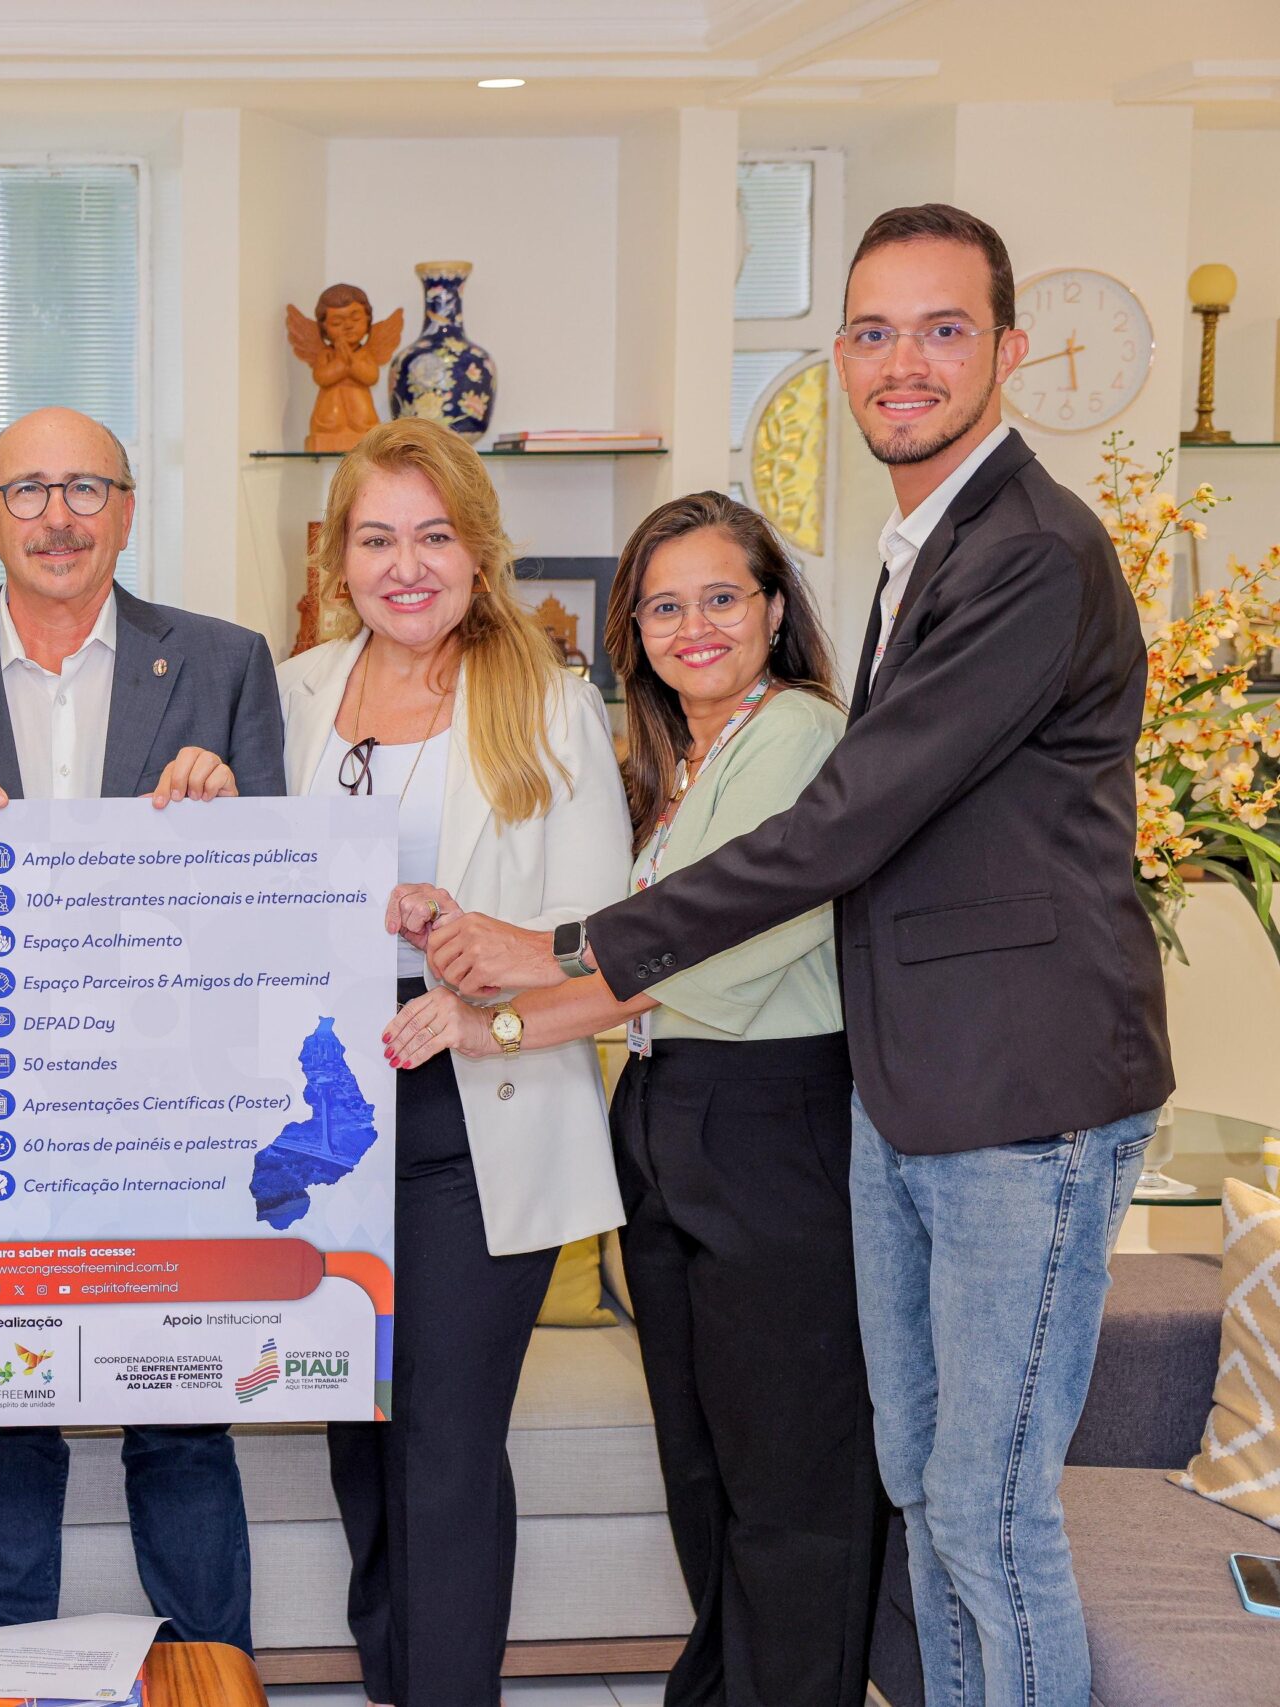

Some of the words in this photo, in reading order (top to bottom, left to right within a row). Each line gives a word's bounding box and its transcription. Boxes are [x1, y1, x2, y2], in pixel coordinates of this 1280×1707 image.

[1036, 290, 1051, 311] 11
[1064, 281, 1082, 304] 12
[1099, 290, 1104, 311] 1
[1015, 311, 1034, 332] 0
[1113, 311, 1128, 333] 2
[1121, 340, 1136, 362] 3
[1010, 372, 1024, 392] 8
[1111, 370, 1125, 389] 4
[1032, 392, 1046, 412] 7
[1059, 397, 1073, 420] 6
[1088, 392, 1103, 413] 5
[23, 852, 77, 867] Amplo
[77, 851, 136, 866] debate
[137, 850, 182, 865] sobre
[183, 849, 251, 868] políticas
[252, 848, 318, 867] públicas
[26, 893, 63, 908] 100+
[64, 892, 165, 910] palestrantes
[167, 891, 243, 906] nacionais
[244, 894, 255, 905] e
[257, 889, 367, 905] internacionais
[23, 934, 80, 952] Espaço
[81, 933, 183, 948] Acolhimento
[23, 976, 80, 993] Espaço
[82, 975, 155, 989] Parceiros
[157, 974, 170, 988] &
[170, 973, 231, 991] Amigos
[233, 972, 254, 987] do
[256, 971, 331, 987] Freemind
[23, 1016, 80, 1031] DEPAD
[82, 1016, 115, 1033] Day
[23, 1057, 44, 1072] 50
[46, 1056, 118, 1071] estandes
[22, 1097, 140, 1115] Apresentações
[142, 1095, 225, 1110] Científicas
[227, 1094, 291, 1113] (Poster)
[23, 1138, 45, 1153] 60
[46, 1138, 90, 1152] horas
[93, 1137, 113, 1152] de
[114, 1137, 171, 1155] painéis
[173, 1140, 183, 1151] e
[184, 1136, 259, 1154] palestras
[23, 1178, 120, 1195] Certificação
[122, 1175, 227, 1191] Internacional
[18, 1247, 55, 1258] saber
[57, 1246, 87, 1258] mais
[89, 1248, 136, 1257] acesse:
[81, 1281, 179, 1296] espíritofreemind
[162, 1314, 203, 1328] Apoio
[206, 1313, 282, 1325] Institucional
[93, 1355, 175, 1365] COORDENADORIA
[176, 1355, 223, 1363] ESTADUAL
[285, 1350, 333, 1359] GOVERNO
[335, 1350, 350, 1358] DO
[115, 1372, 128, 1381] ÀS
[130, 1373, 168, 1381] DROGAS
[178, 1372, 223, 1380] FOMENTO
[141, 1364, 223, 1372] ENFRENTAMENTO
[285, 1358, 349, 1377] PIAUÍ
[126, 1382, 141, 1390] AO
[142, 1382, 173, 1390] LAZER
[180, 1381, 223, 1389] CENDFOL
